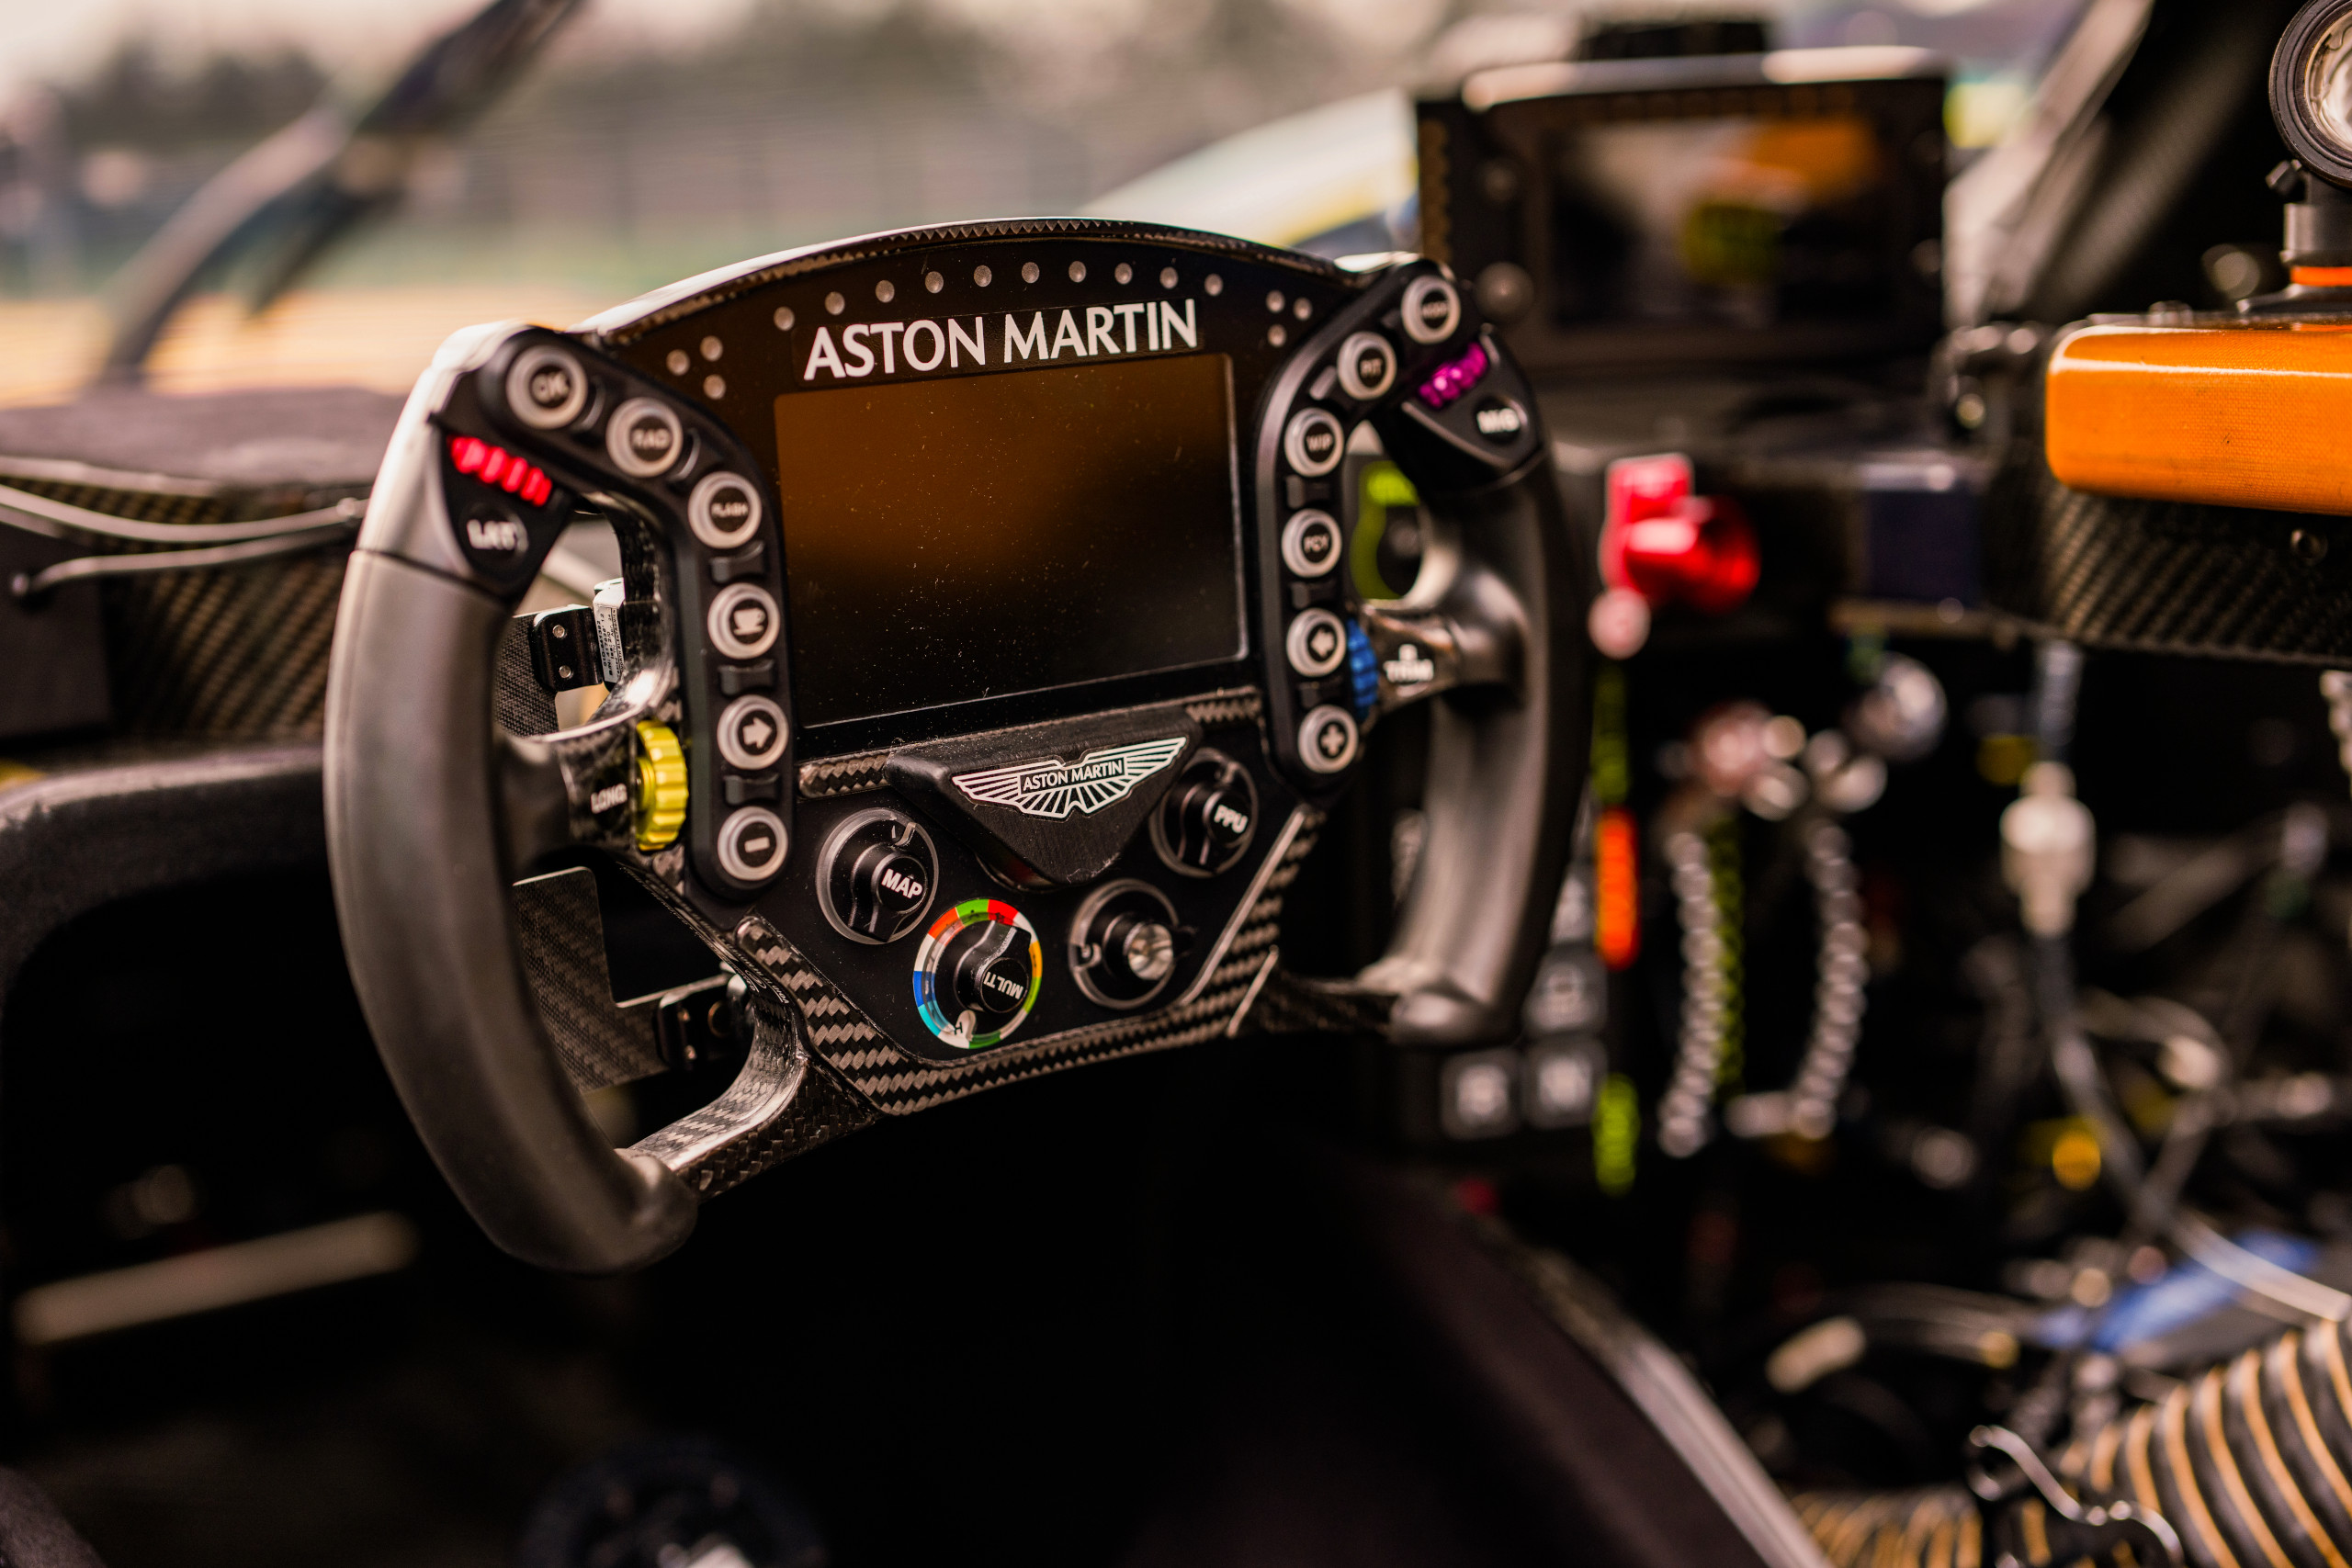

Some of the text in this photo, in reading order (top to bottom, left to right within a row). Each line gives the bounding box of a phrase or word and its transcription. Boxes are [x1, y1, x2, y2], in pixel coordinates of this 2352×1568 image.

[803, 299, 1198, 381] ASTON MARTIN
[531, 371, 569, 403] OK
[631, 428, 671, 450] RAD
[710, 502, 750, 518] FLASH
[1023, 760, 1124, 792] ASTON MARTIN
[590, 783, 628, 815] LONG
[1213, 804, 1249, 834] PPU
[880, 868, 923, 899] MAP
[982, 971, 1024, 1000] MULTI
